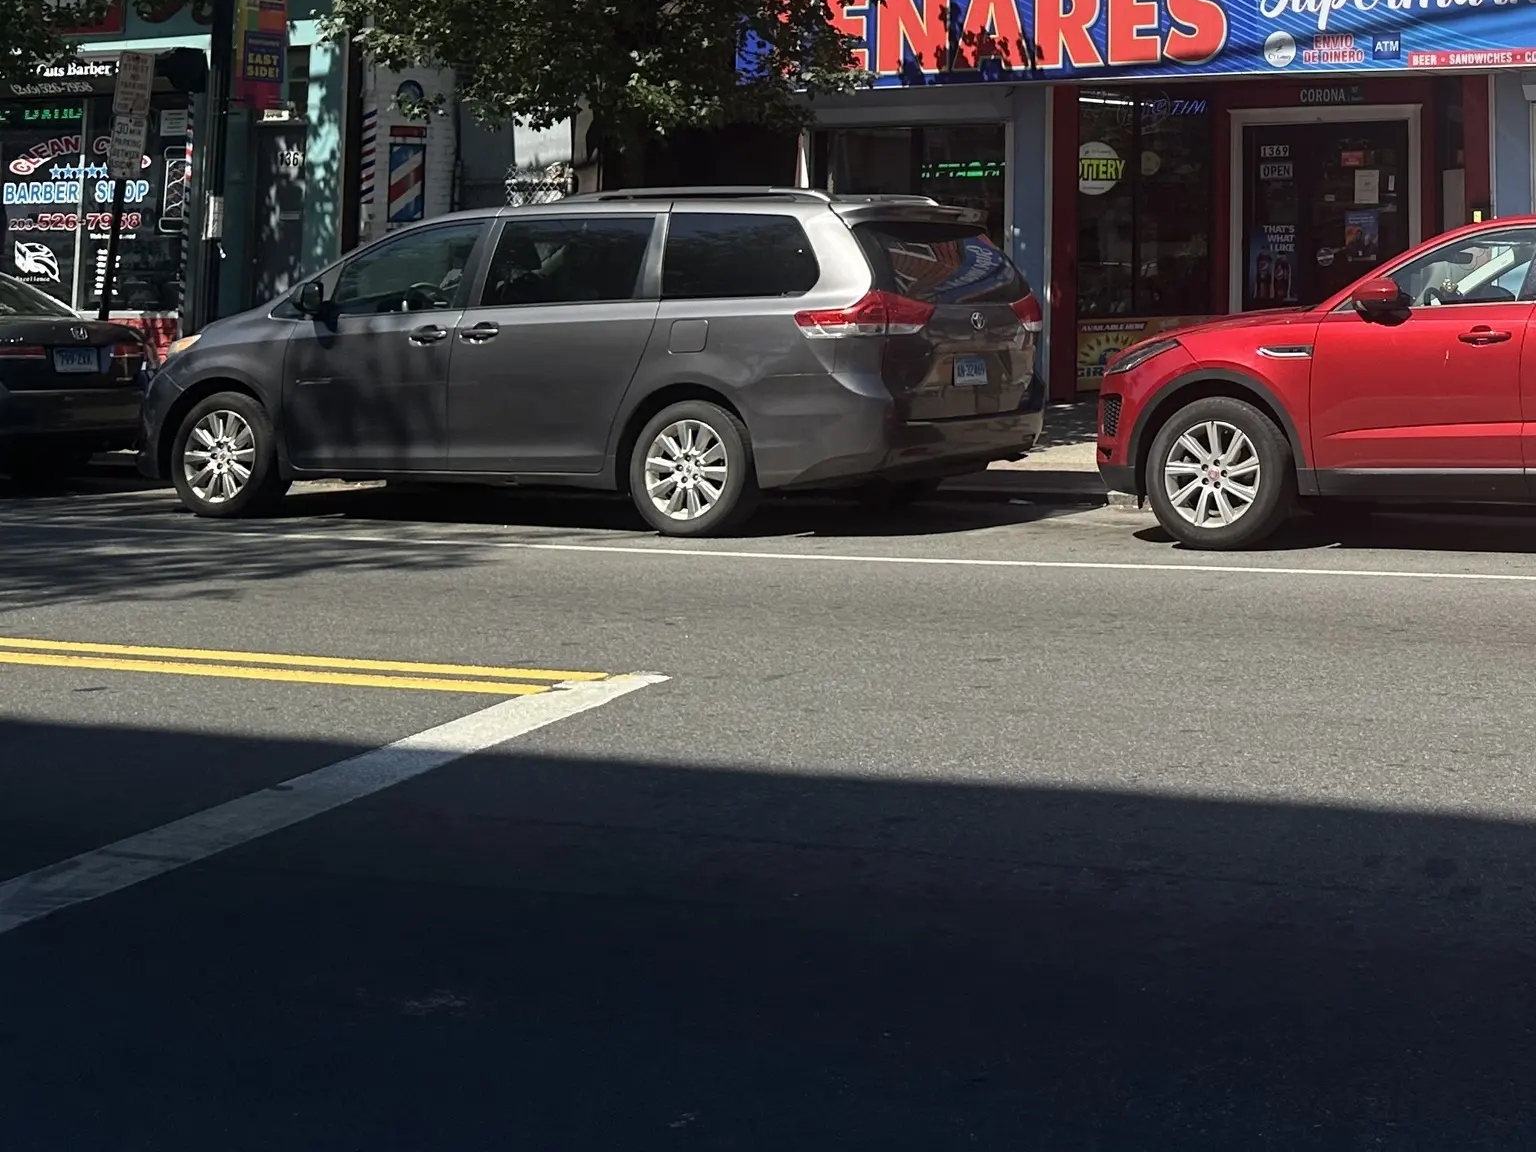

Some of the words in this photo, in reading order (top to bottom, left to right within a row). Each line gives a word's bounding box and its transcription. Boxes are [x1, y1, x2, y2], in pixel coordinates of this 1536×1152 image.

[1313, 34, 1354, 49] ENVIO
[1374, 40, 1399, 52] ATM
[248, 52, 280, 66] EAST
[1303, 49, 1319, 64] DE
[1321, 49, 1364, 64] DINERO
[1412, 54, 1437, 66] BEER
[1449, 51, 1512, 65] SANDWICHES
[66, 62, 111, 77] Barber
[247, 65, 279, 78] SIDE!
[1300, 88, 1346, 103] CORONA
[9, 136, 81, 175] CLEAN
[279, 151, 306, 166] 1361
[1262, 146, 1289, 157] 1369
[1263, 165, 1291, 177] OPEN
[3, 181, 79, 204] BARBER
[1263, 225, 1295, 233] THAT'S
[1267, 234, 1295, 243] WHAT
[1274, 243, 1295, 252] LIKE
[1081, 323, 1125, 332] AVAILABLE
[1125, 322, 1146, 330] HERE
